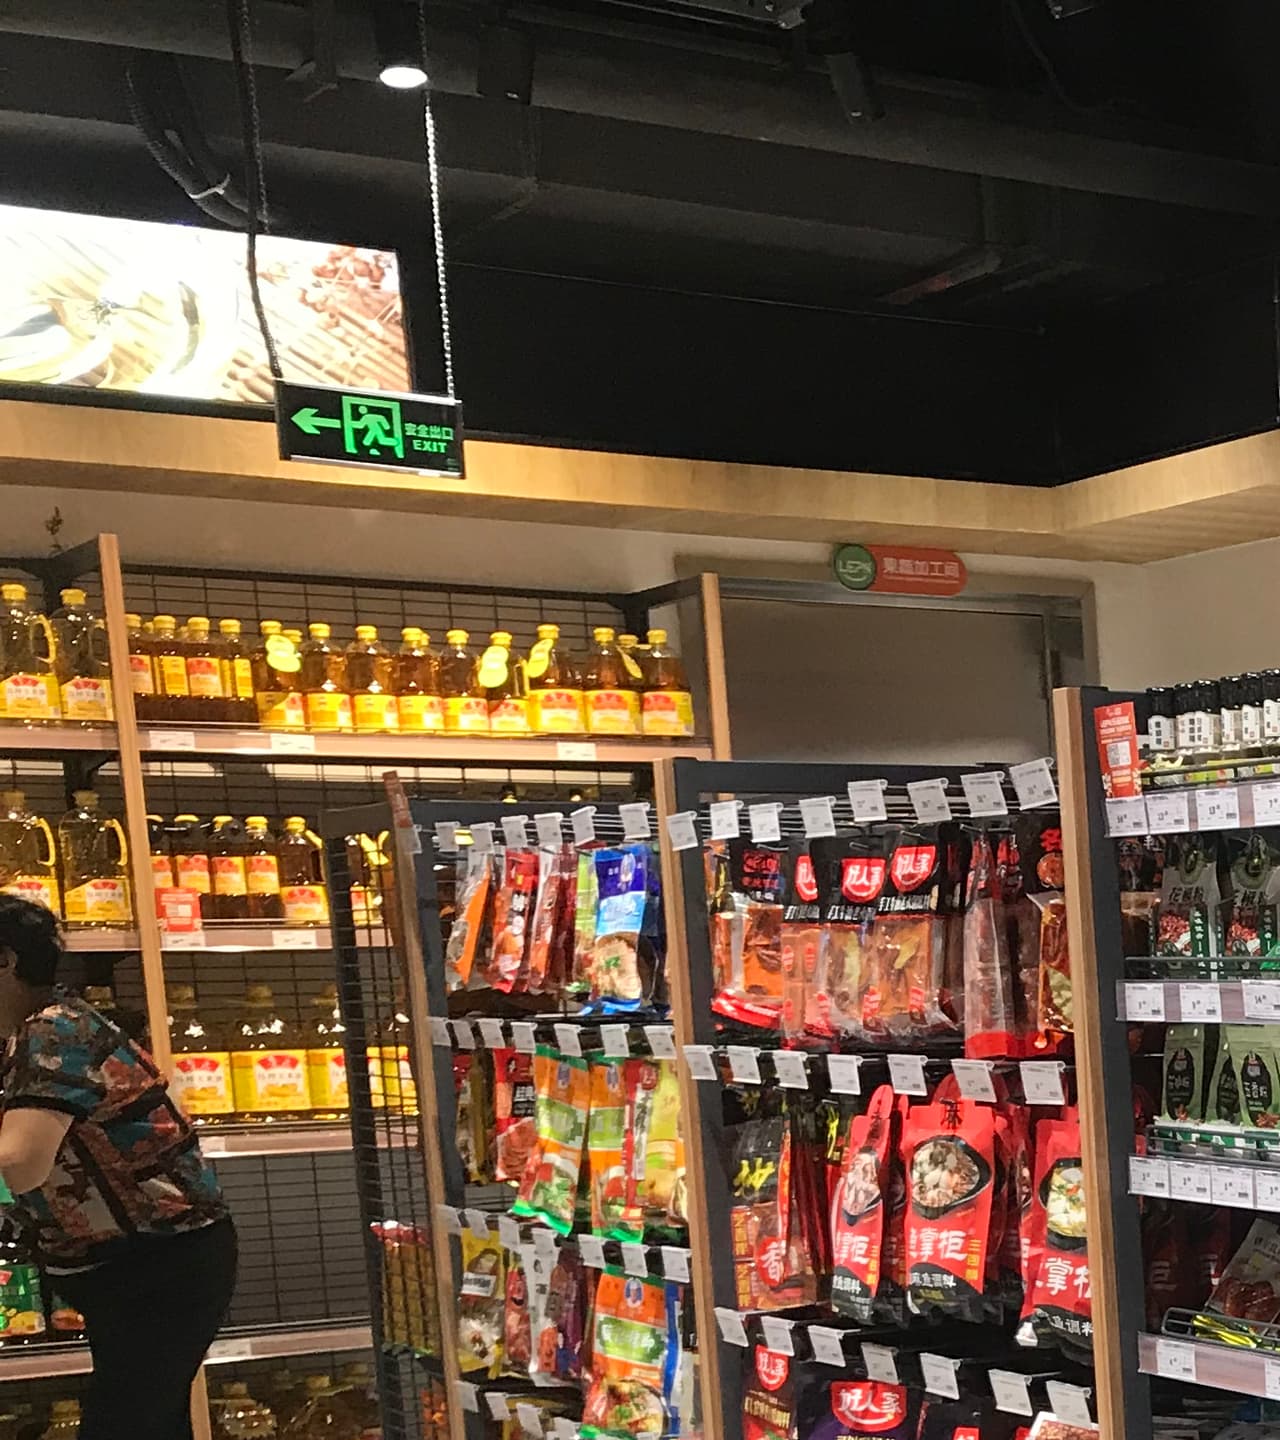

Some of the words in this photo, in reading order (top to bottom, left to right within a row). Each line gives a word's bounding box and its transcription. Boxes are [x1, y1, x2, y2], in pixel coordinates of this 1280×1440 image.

[405, 423, 454, 440] 安全出口
[413, 440, 448, 453] EXIT
[838, 1388, 903, 1415] 好人家
